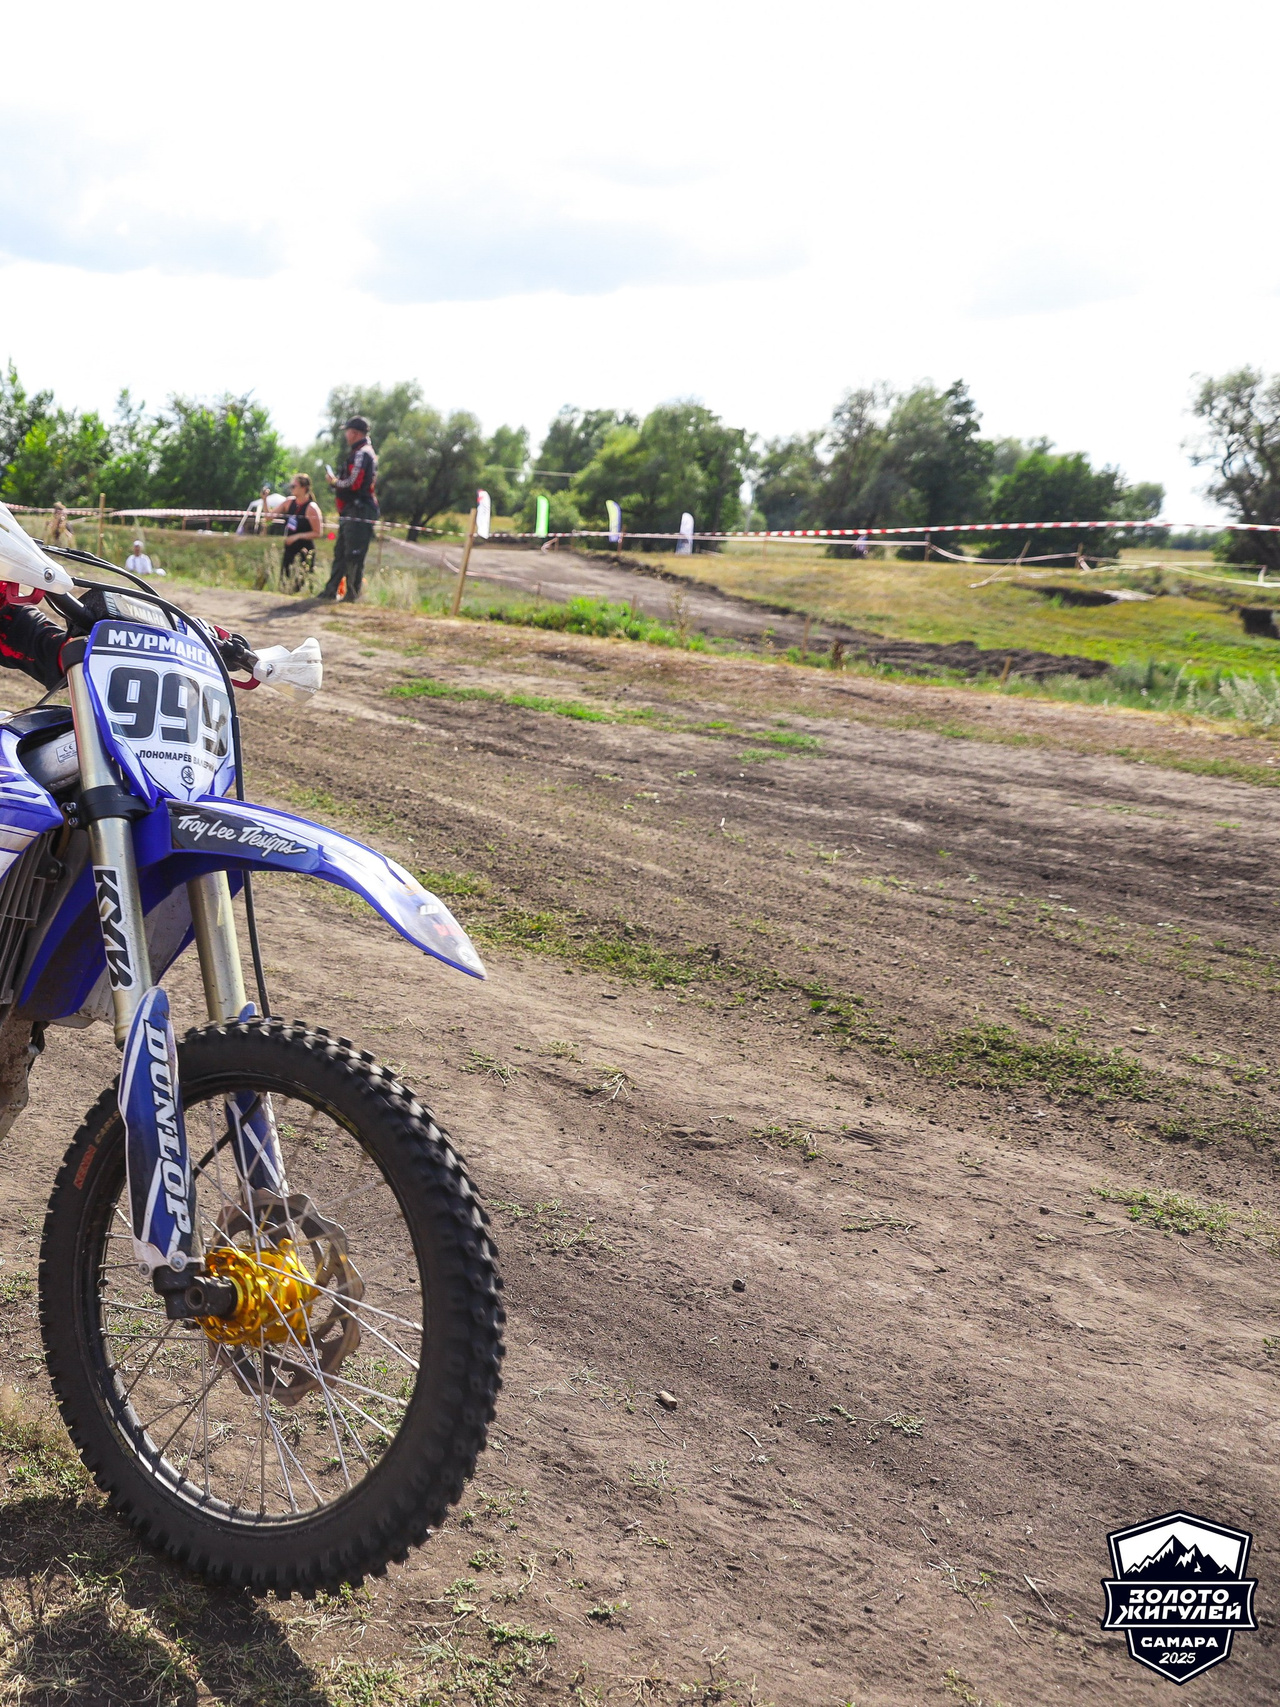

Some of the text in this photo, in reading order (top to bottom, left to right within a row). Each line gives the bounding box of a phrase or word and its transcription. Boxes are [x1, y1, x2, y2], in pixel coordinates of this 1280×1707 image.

[126, 603, 167, 628] YAMAHA
[107, 667, 230, 758] 999
[140, 750, 192, 762] ПОНОМАРЁВ
[177, 814, 307, 857] Troy Lee Designs
[93, 866, 135, 990] KYB
[144, 1019, 193, 1235] DUNLOP
